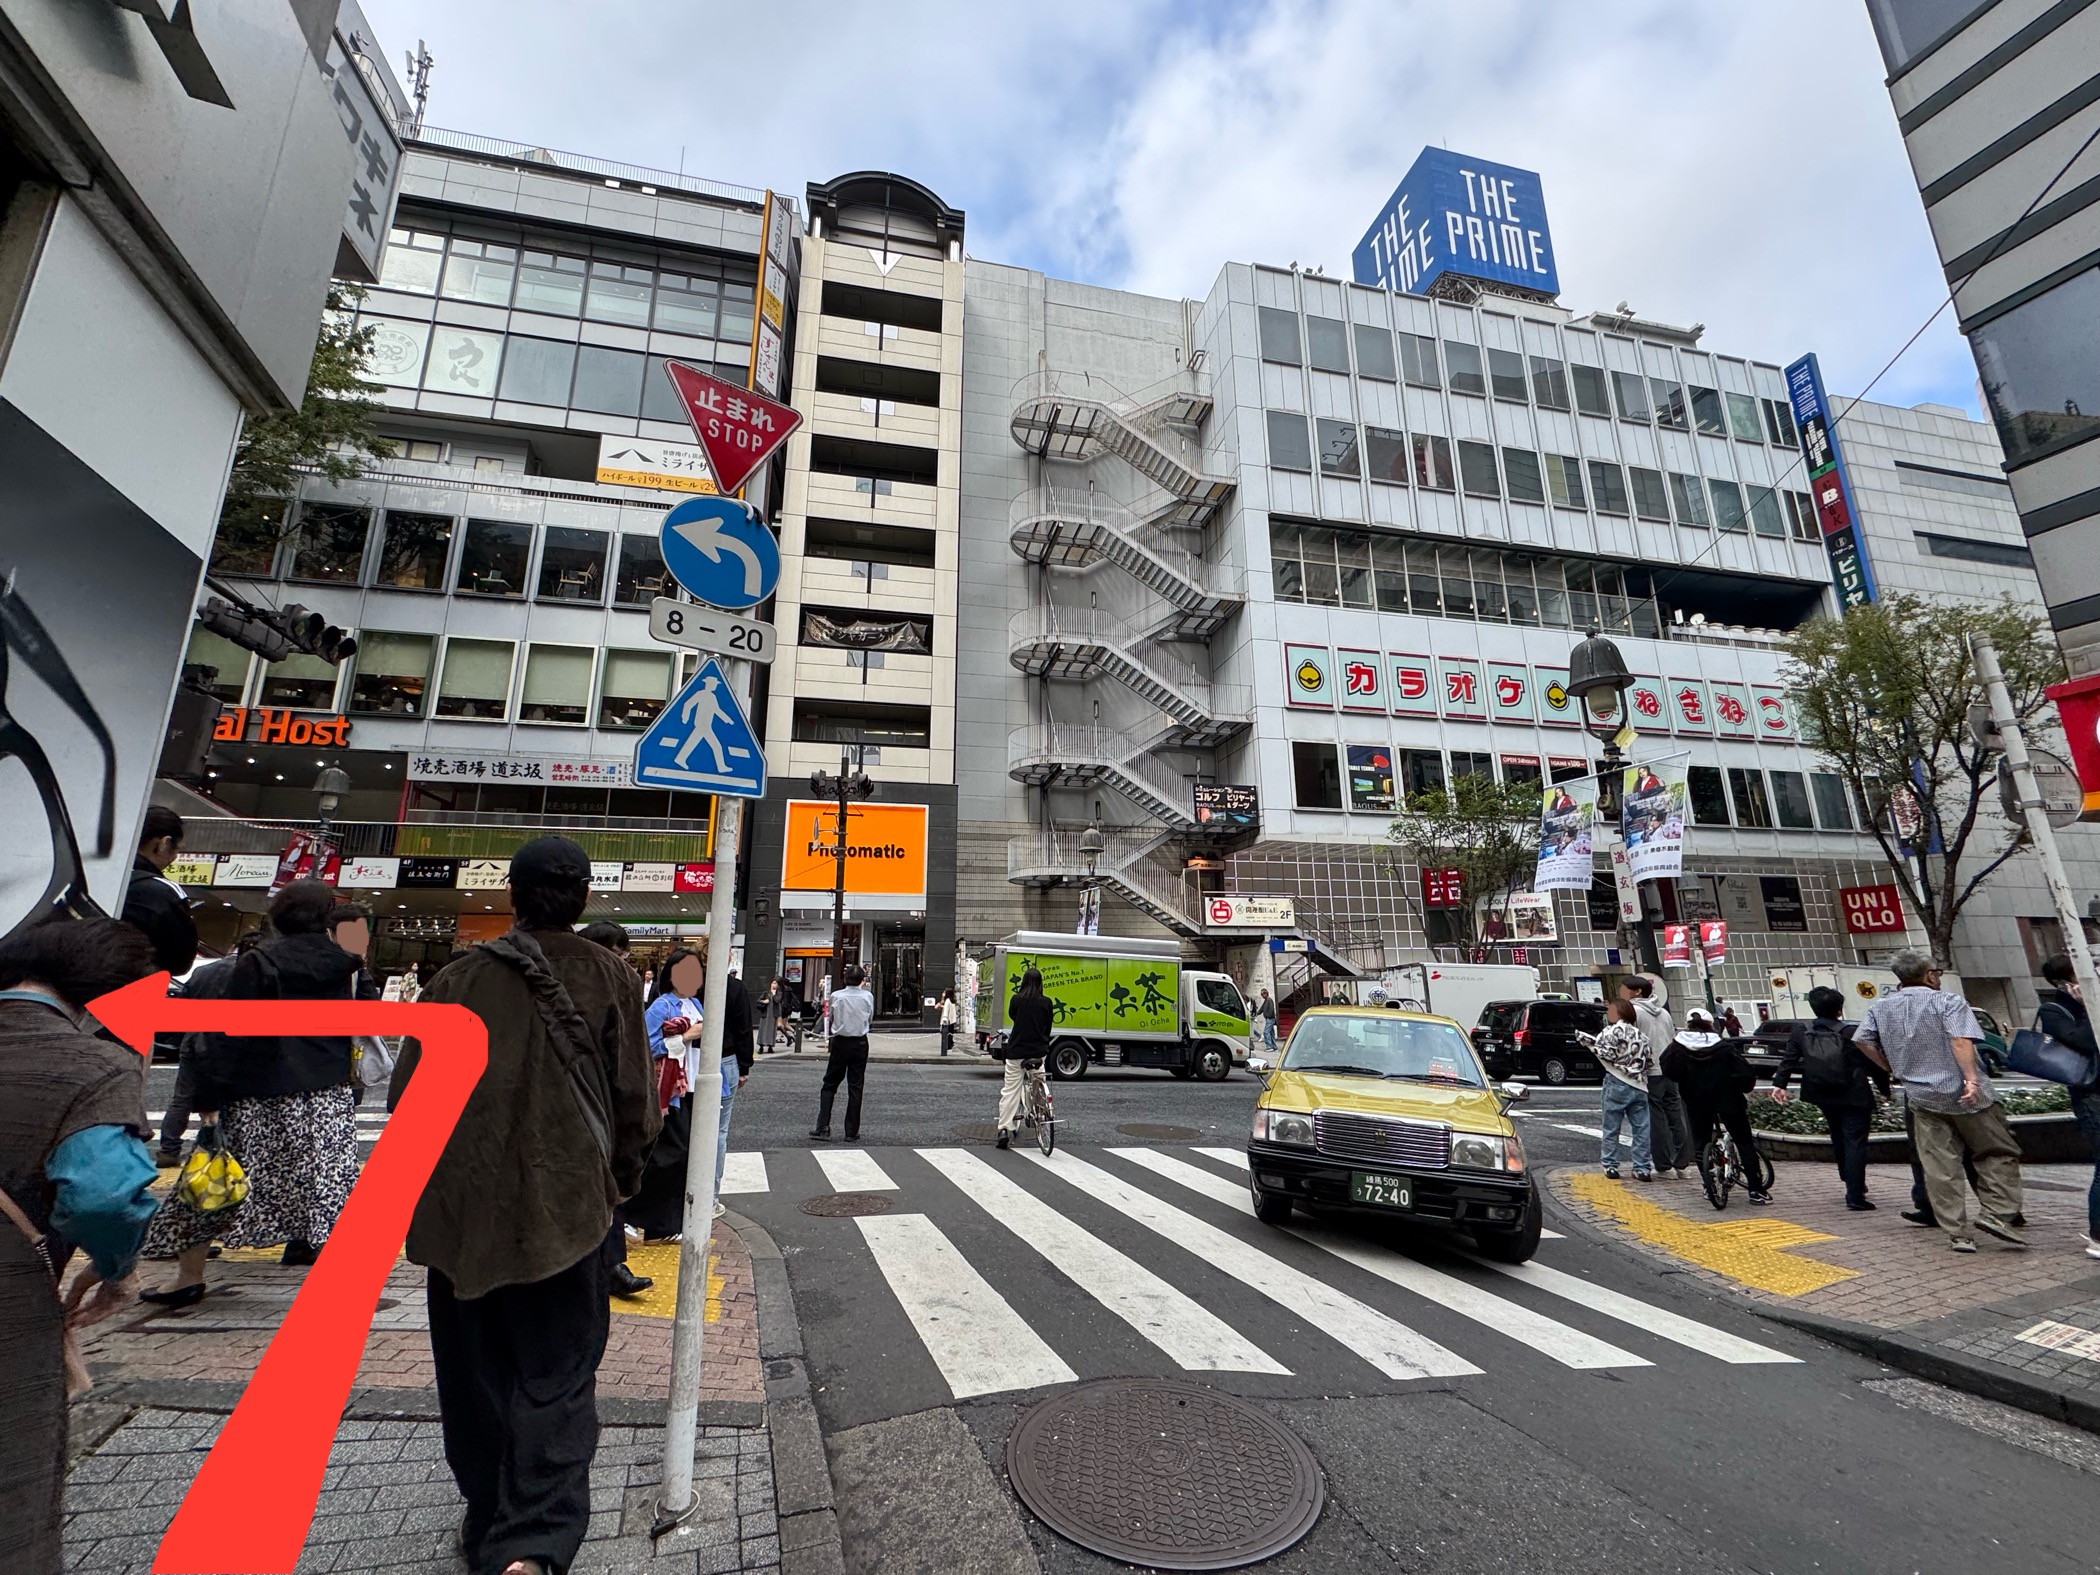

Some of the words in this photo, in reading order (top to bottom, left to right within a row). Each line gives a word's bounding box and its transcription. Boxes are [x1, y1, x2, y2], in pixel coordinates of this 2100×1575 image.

[1459, 169, 1521, 223] THE
[1369, 193, 1410, 278] THE
[1445, 210, 1548, 275] PRIME
[1790, 363, 1812, 391] THE
[694, 386, 776, 433] 止まれ
[1794, 384, 1819, 422] PRIME
[707, 417, 763, 453] STOP
[1343, 660, 1525, 708] カラオケ
[259, 708, 351, 747] Host
[491, 761, 544, 781] 道玄坂
[1502, 757, 1517, 765] OPEN
[219, 855, 230, 863] 2F
[807, 841, 906, 860] Phoomatic
[1612, 849, 1636, 917] 道玄坂
[1510, 896, 1541, 905] LifeWear
[1846, 891, 1889, 911] UNI
[1279, 910, 1292, 920] 2F
[1850, 909, 1896, 932] QLO
[623, 925, 670, 938] FamilyMart
[1041, 972, 1070, 982] JAPAN'S
[1071, 970, 1085, 978] No.1
[1043, 980, 1066, 990] GREEN
[1066, 977, 1080, 986] TEA
[1081, 973, 1104, 984] BRAND
[1779, 993, 1801, 1001] クール
[1139, 1018, 1149, 1029] Oi
[1150, 1015, 1171, 1027] Ocha
[1365, 1174, 1383, 1186] 練馬
[1383, 1176, 1399, 1188] 500
[1364, 1184, 1409, 1206] 72-40
